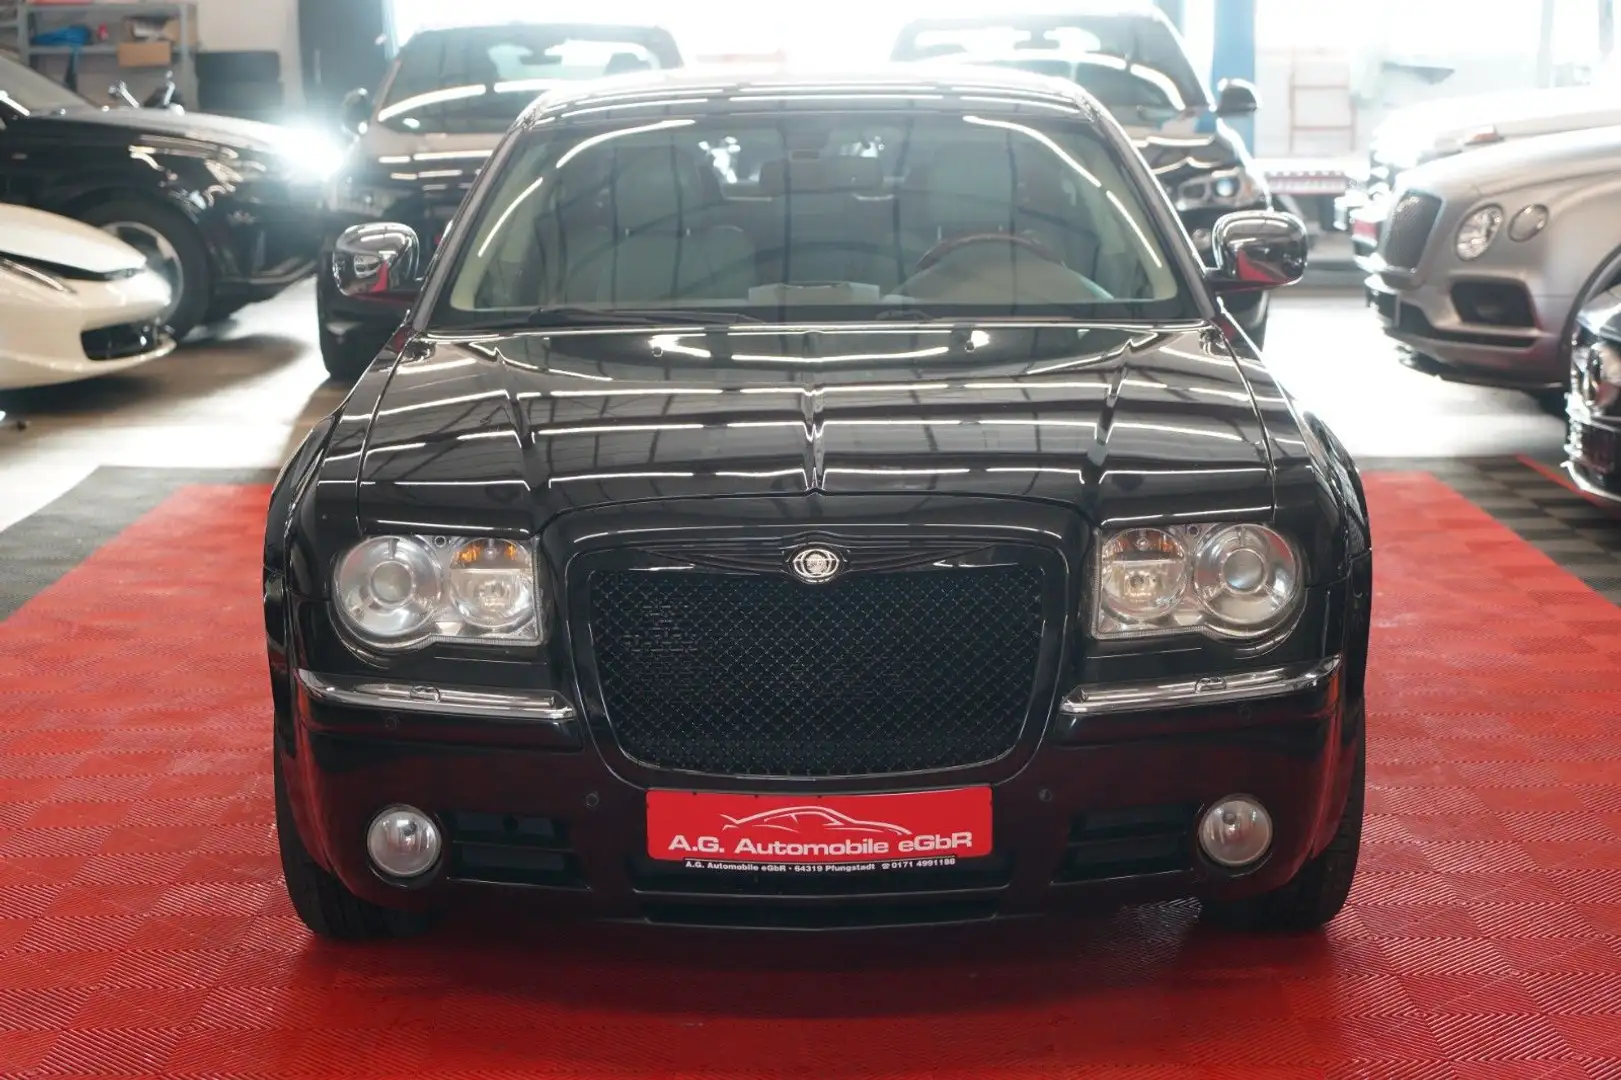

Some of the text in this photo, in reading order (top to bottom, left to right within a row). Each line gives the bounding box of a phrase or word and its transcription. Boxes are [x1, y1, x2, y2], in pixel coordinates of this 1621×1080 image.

[668, 832, 973, 856] A.G. Automobile eGbR
[685, 860, 704, 869] A.G.
[707, 862, 759, 872] Automobile
[761, 864, 787, 872] eGbR
[794, 864, 823, 873] 64319
[825, 863, 875, 874] Pfungstadt
[891, 860, 913, 869] 0171
